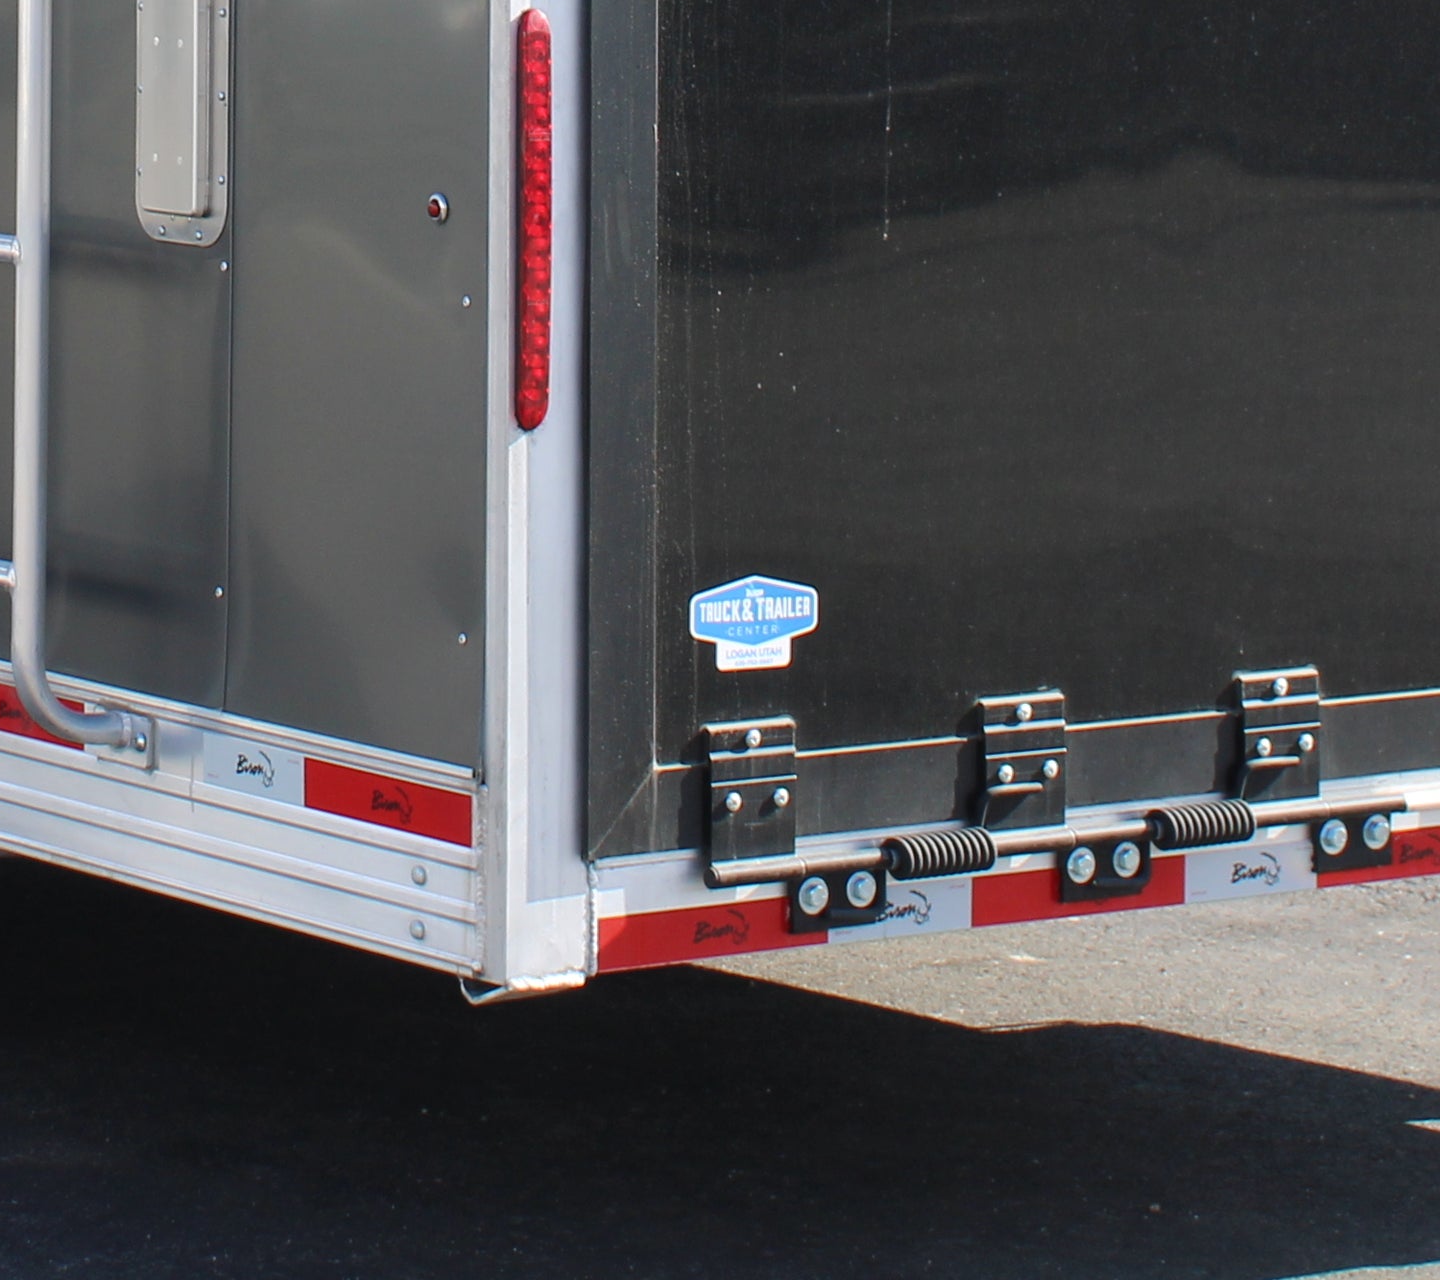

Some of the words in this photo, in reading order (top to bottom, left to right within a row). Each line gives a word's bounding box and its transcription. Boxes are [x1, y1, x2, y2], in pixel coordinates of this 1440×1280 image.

[699, 600, 740, 623] TRUCK
[755, 596, 811, 621] TRAILER
[727, 624, 778, 637] CENTER
[725, 648, 757, 660] LOGAN
[759, 646, 782, 658] UTAH
[236, 754, 264, 775] Bison
[1231, 862, 1268, 884] Bison
[693, 921, 734, 945] Bison
